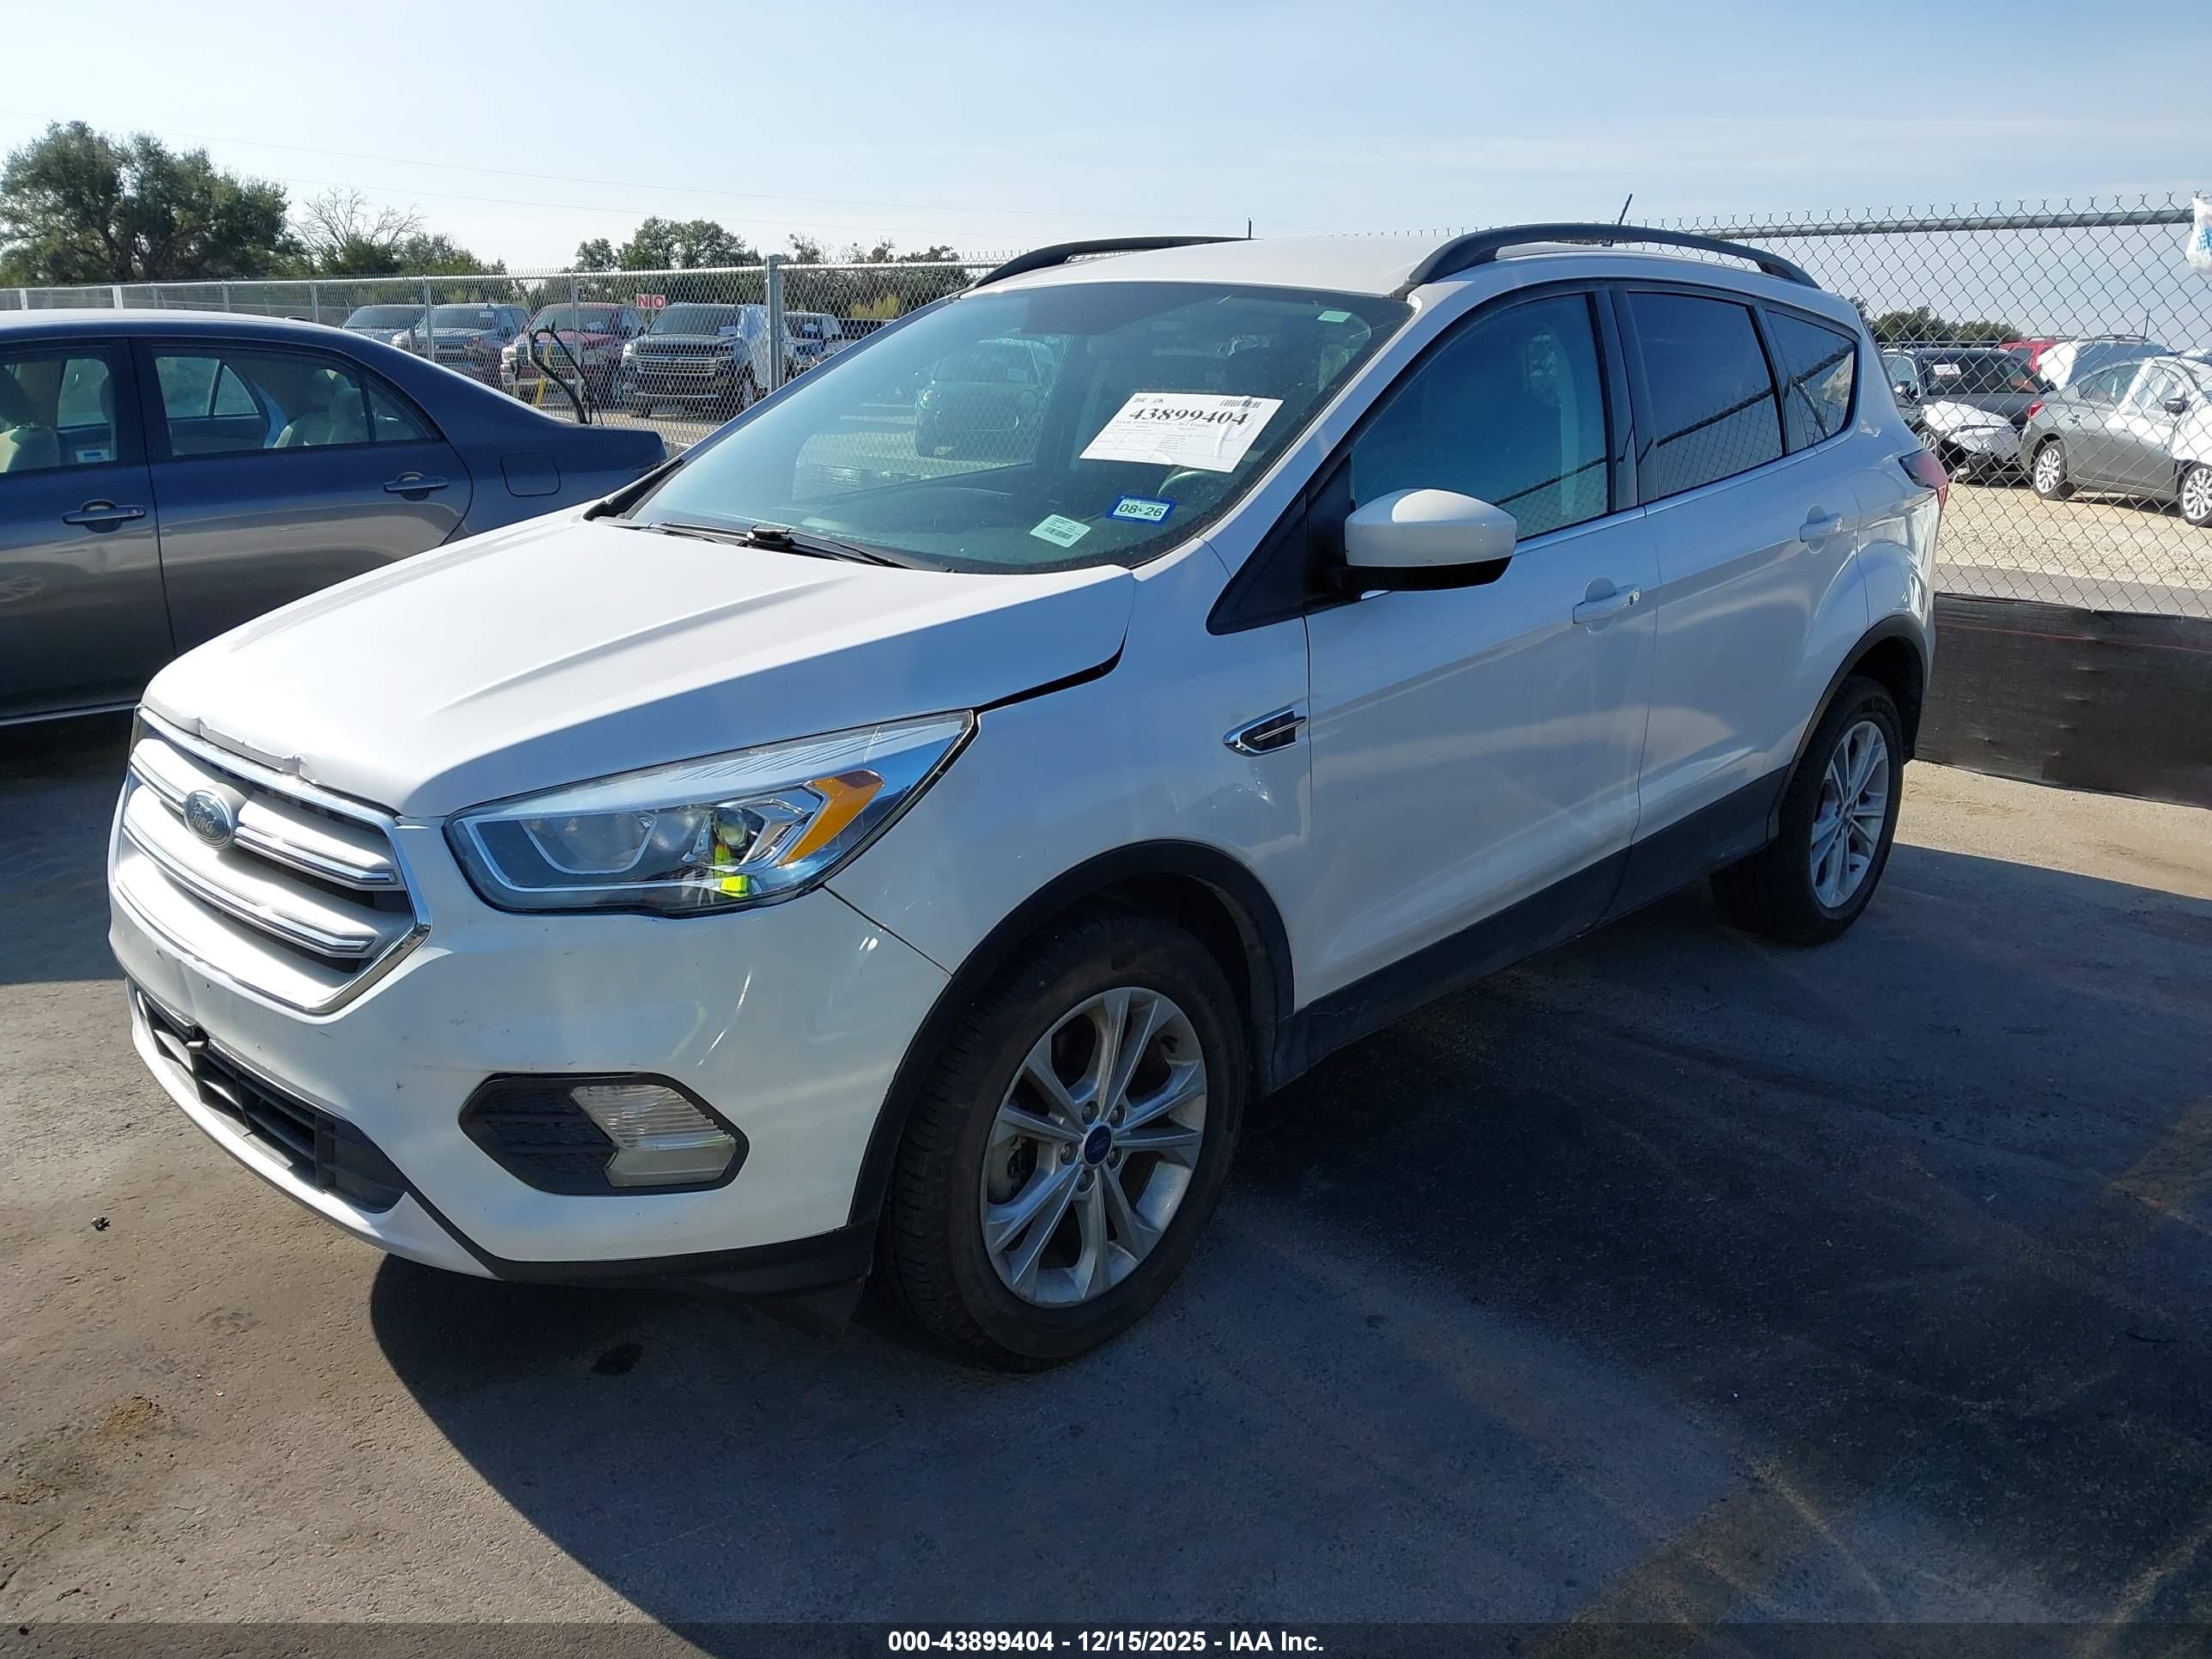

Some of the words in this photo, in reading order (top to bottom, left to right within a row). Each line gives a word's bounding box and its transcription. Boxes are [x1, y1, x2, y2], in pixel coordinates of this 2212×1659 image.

[638, 295, 665, 309] NO
[1128, 408, 1249, 425] 43899404
[191, 799, 216, 835] Ford
